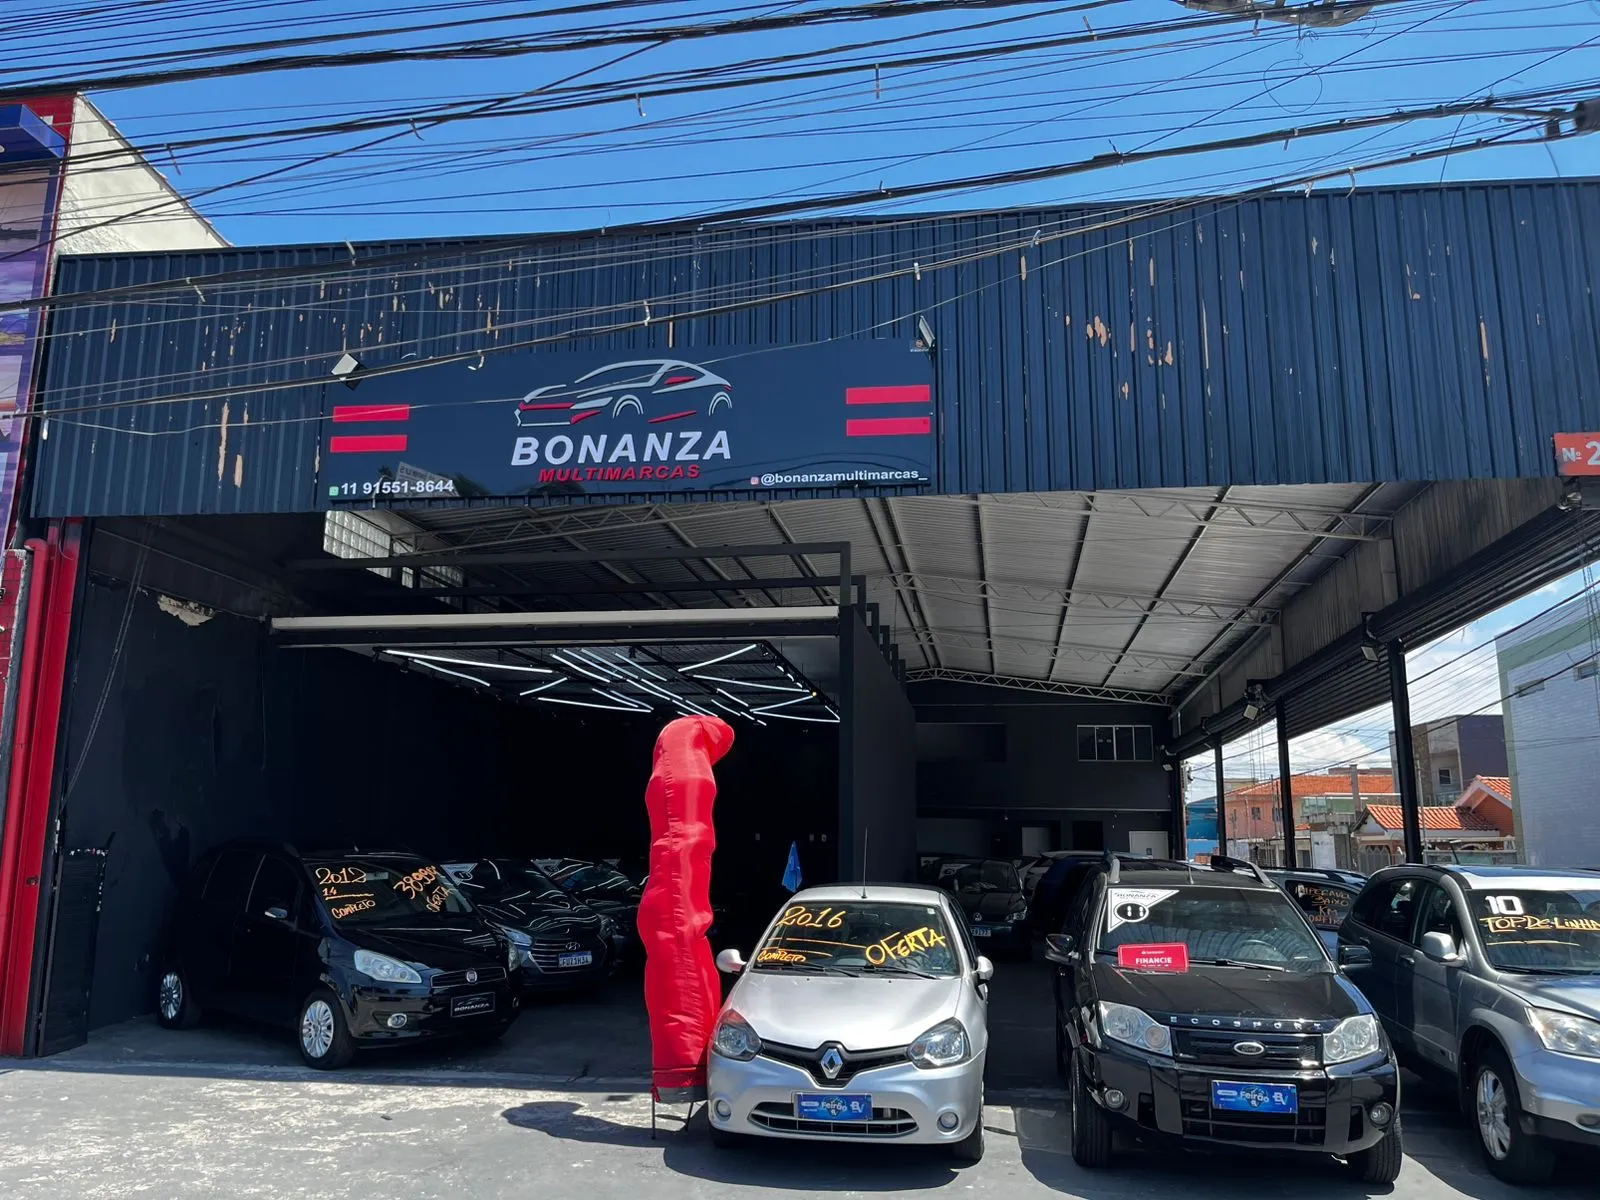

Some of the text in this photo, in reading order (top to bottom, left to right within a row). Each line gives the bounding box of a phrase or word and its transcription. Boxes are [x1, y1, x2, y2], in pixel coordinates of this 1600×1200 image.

[511, 430, 731, 466] BONANZA
[538, 464, 700, 482] MULTIMARCAS
[760, 470, 928, 486] @bonanzamultimarcas_
[341, 480, 454, 495] 11 91551-8644
[315, 867, 367, 885] 2012
[1485, 896, 1524, 915] 10
[776, 906, 846, 928] 2016
[866, 927, 946, 964] OFERTA
[1136, 957, 1172, 965] FINANCIE
